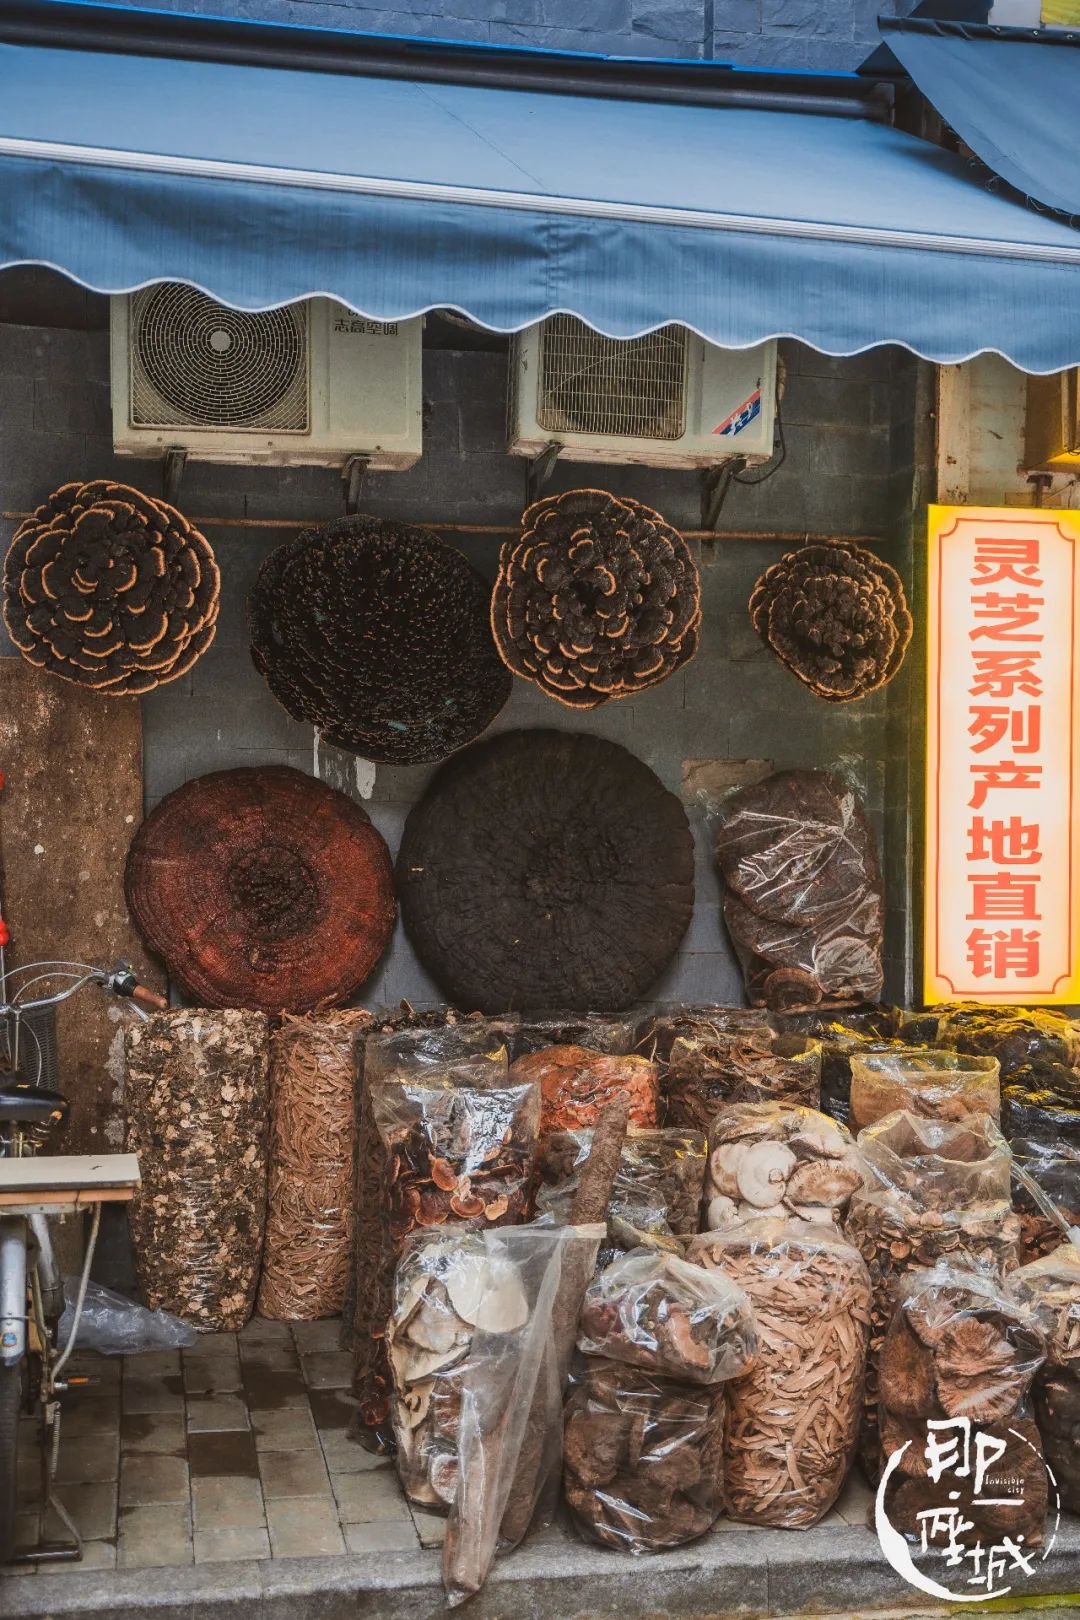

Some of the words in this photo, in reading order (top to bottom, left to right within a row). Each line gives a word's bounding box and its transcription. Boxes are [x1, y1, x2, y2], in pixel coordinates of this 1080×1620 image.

[334, 320, 398, 336] 志高空调
[966, 537, 1044, 979] 灵芝系列产地直销
